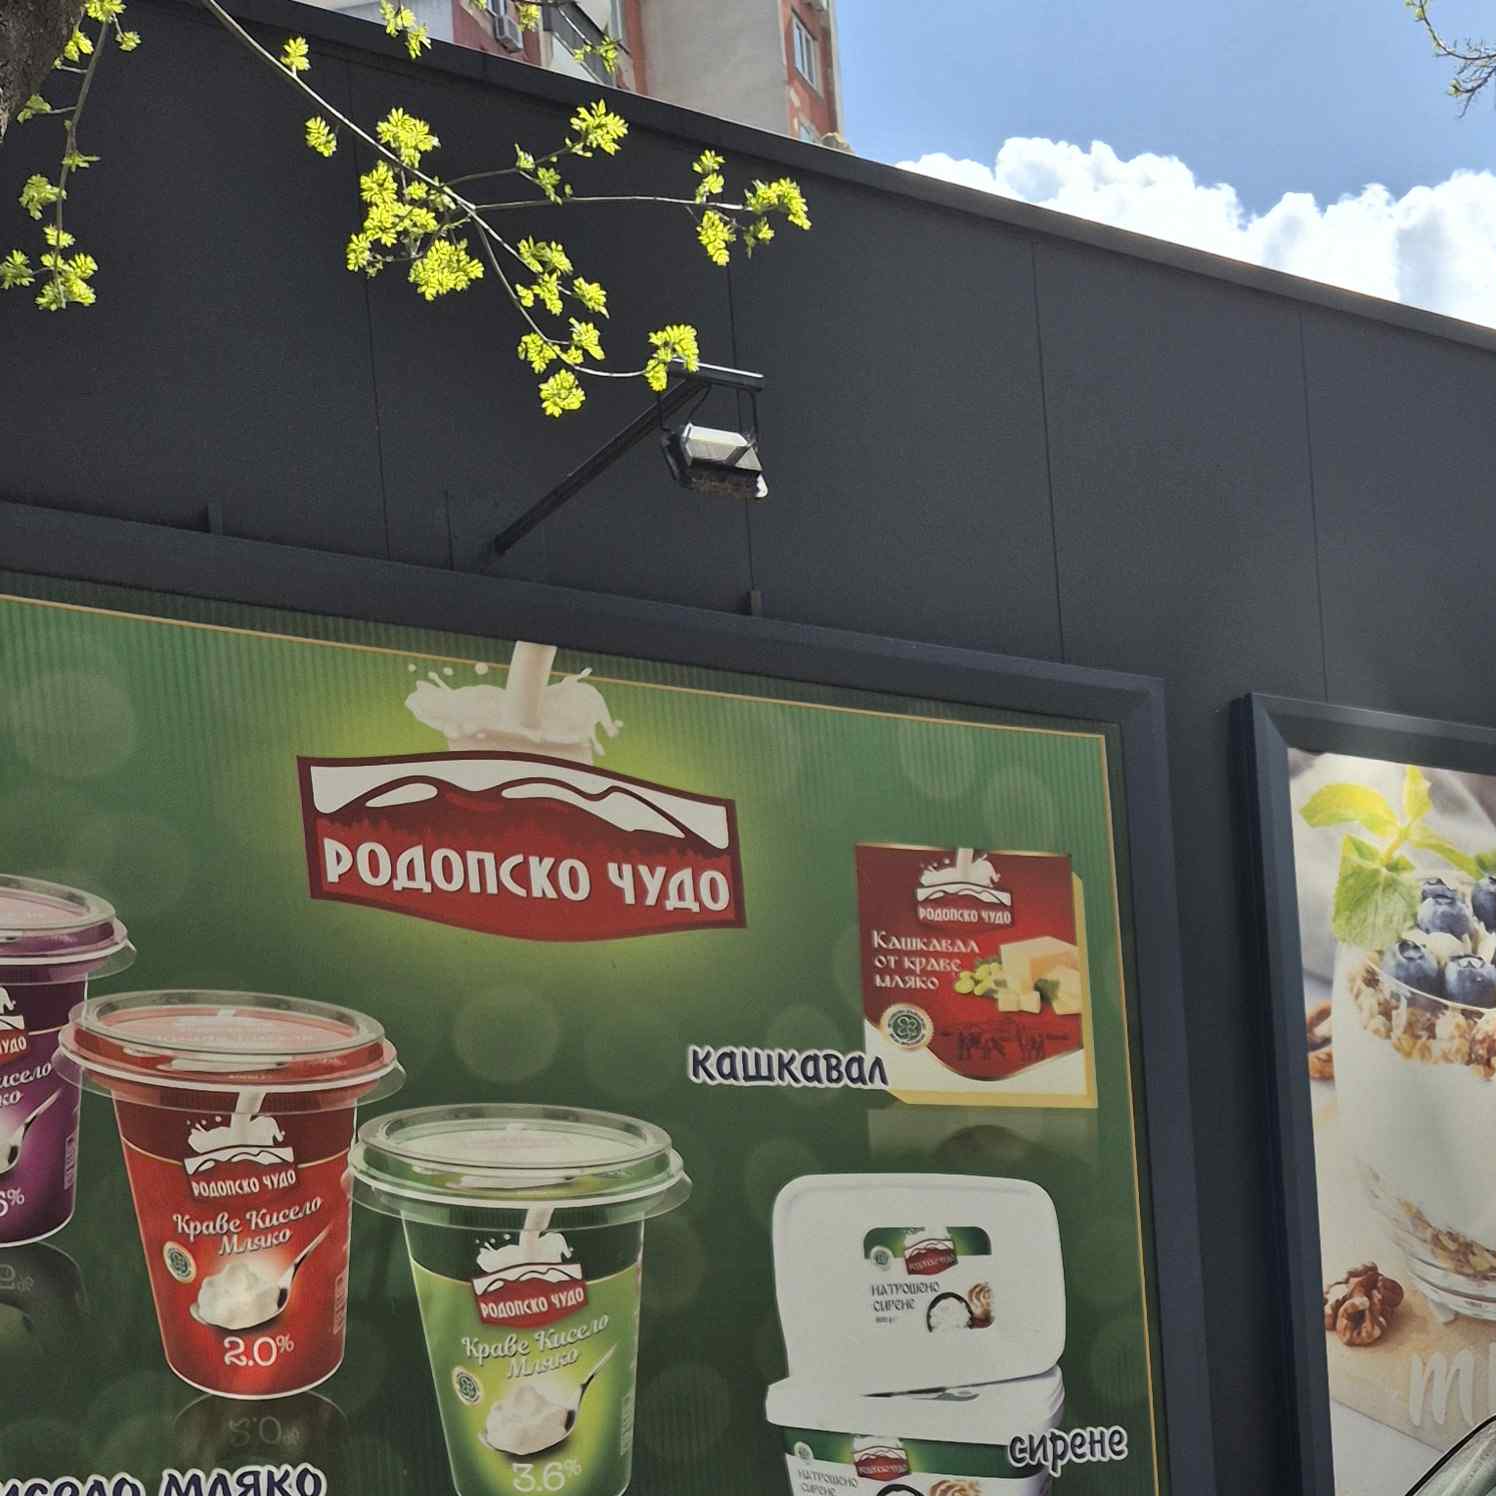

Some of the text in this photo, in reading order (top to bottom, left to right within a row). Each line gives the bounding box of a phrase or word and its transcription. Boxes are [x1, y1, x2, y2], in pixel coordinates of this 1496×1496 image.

[322, 838, 731, 912] РОДОПСКО ЧУДО
[918, 906, 1012, 925] РОДОПСКО ЧУДО
[0, 1036, 27, 1054] УДО
[691, 1050, 888, 1085] кашкавал
[193, 1169, 296, 1198] РОДОПСКО ЧУДО
[173, 1196, 322, 1242] Краве Кисело
[218, 1228, 292, 1256] Мляко
[480, 1287, 585, 1318] РОДОПСКО ЧУДО
[223, 1334, 294, 1367] 2.0%
[461, 1314, 610, 1366] Краве Кисело
[507, 1348, 581, 1379] Мляко
[1009, 1428, 1127, 1472] сирене
[511, 1458, 582, 1493] 3.6%
